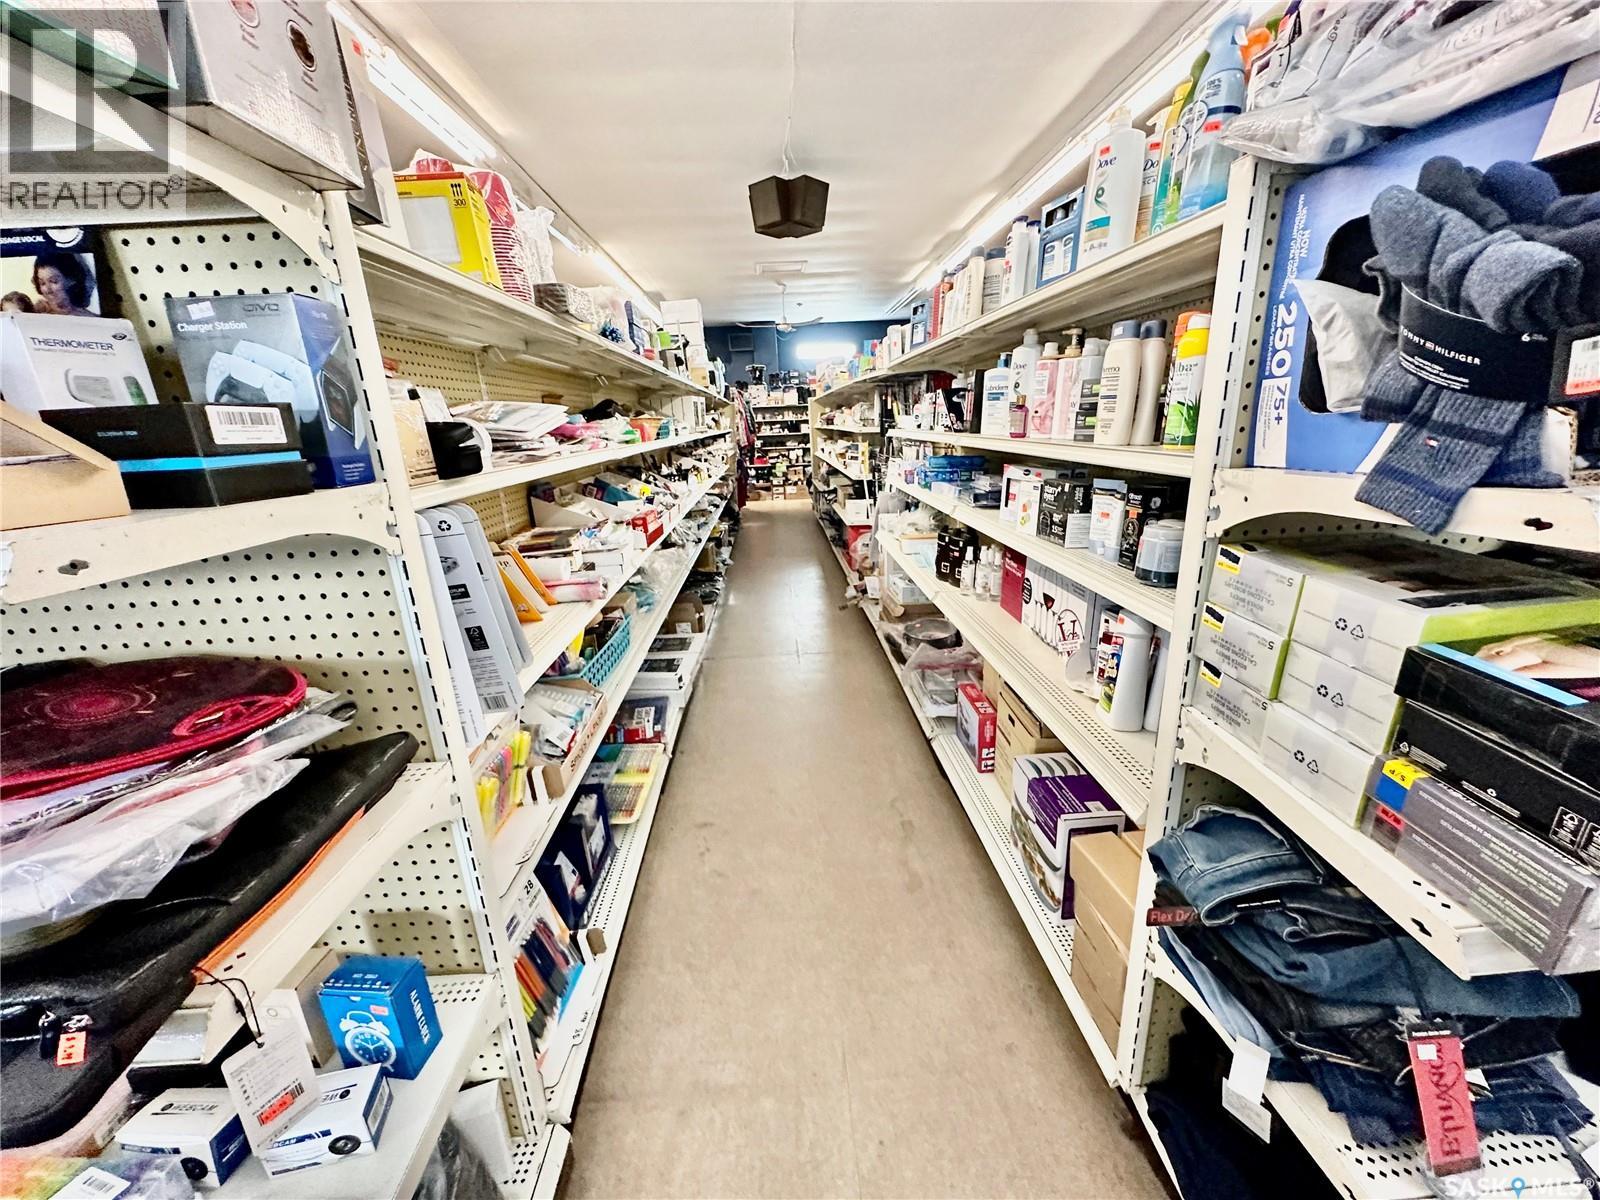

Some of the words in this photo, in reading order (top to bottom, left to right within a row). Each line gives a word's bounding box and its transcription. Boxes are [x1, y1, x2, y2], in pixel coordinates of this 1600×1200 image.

[453, 199, 467, 207] 300
[22, 235, 47, 243] VOCAL
[1300, 228, 1311, 257] NOW
[177, 322, 215, 334] Charger
[215, 320, 249, 331] Station
[1270, 300, 1298, 377] 250
[1521, 332, 1531, 342] 6
[30, 336, 115, 352] THERMOMETER
[1435, 344, 1481, 365] HILFIGER
[1273, 382, 1289, 426] 75+
[1286, 577, 1294, 587] 5
[1266, 640, 1275, 650] 5
[1260, 701, 1268, 711] 5
[1150, 912, 1173, 923] Flex
[409, 989, 425, 1022] ALARM
[418, 1019, 432, 1045] CLOCK
